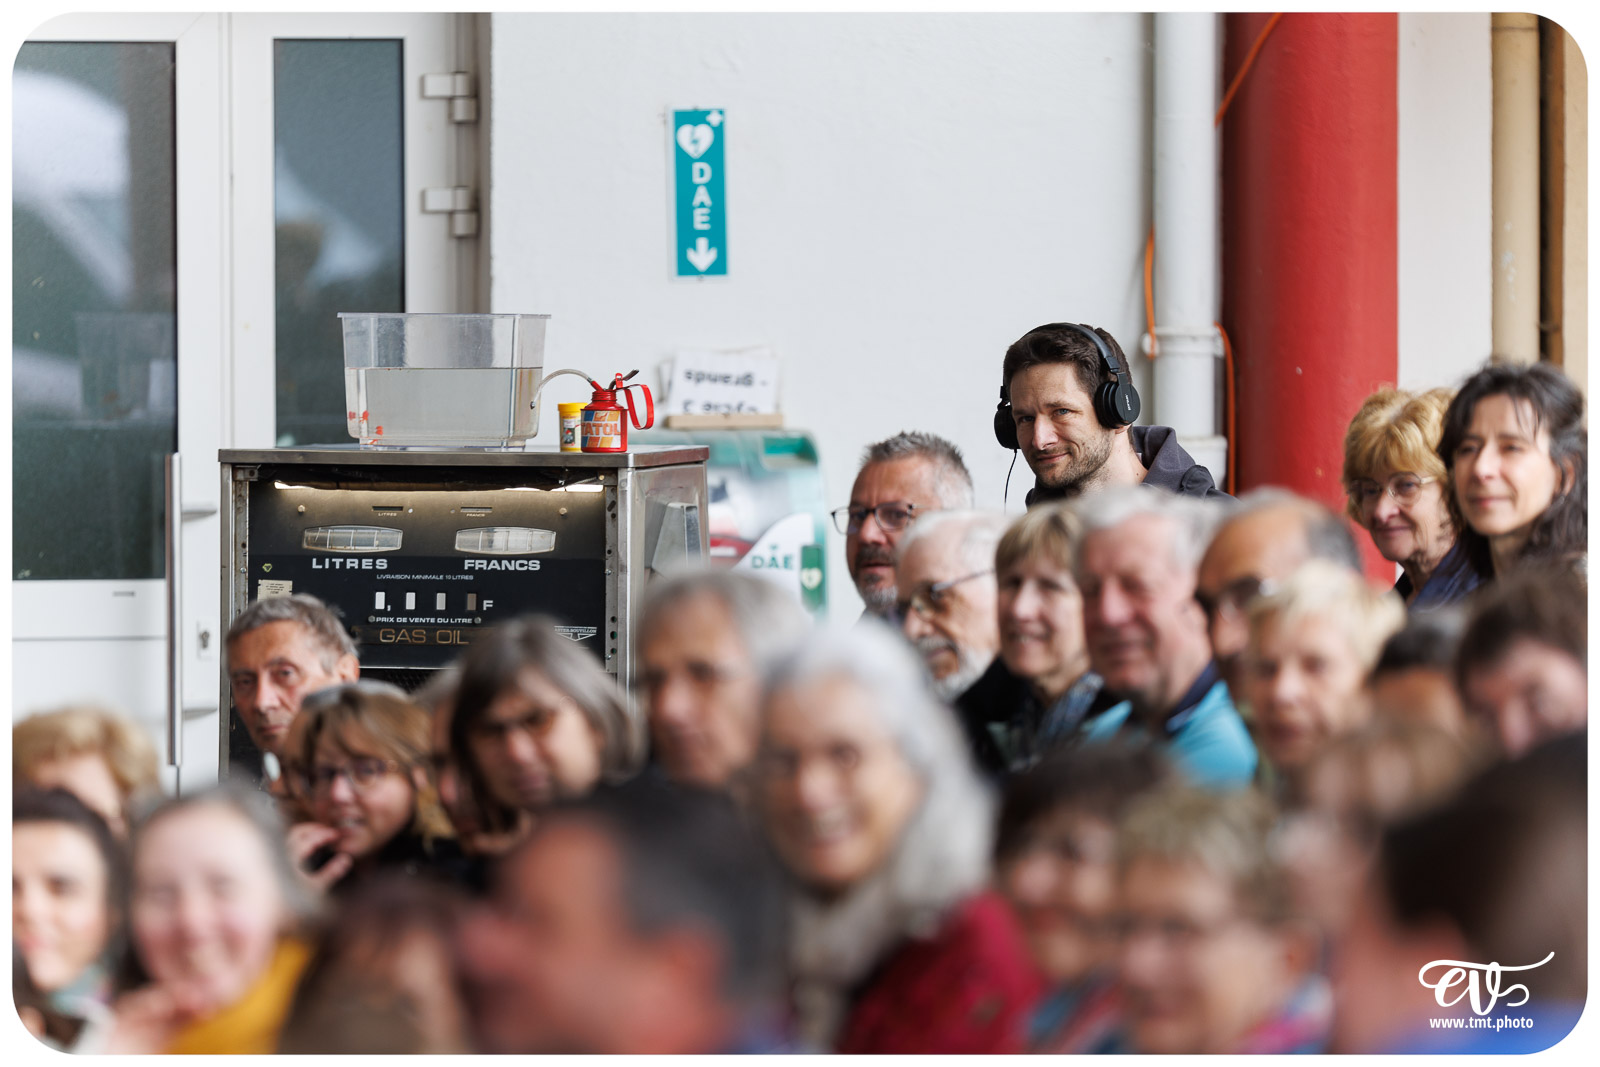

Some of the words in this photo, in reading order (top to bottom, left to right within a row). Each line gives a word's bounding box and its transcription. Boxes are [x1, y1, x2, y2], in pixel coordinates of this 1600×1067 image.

[692, 162, 712, 230] DAE
[312, 558, 388, 570] LITRES
[464, 559, 541, 571] FRANCS
[751, 553, 794, 569] DAE
[483, 600, 493, 611] F
[379, 628, 427, 644] GAS
[436, 629, 470, 645] OIL
